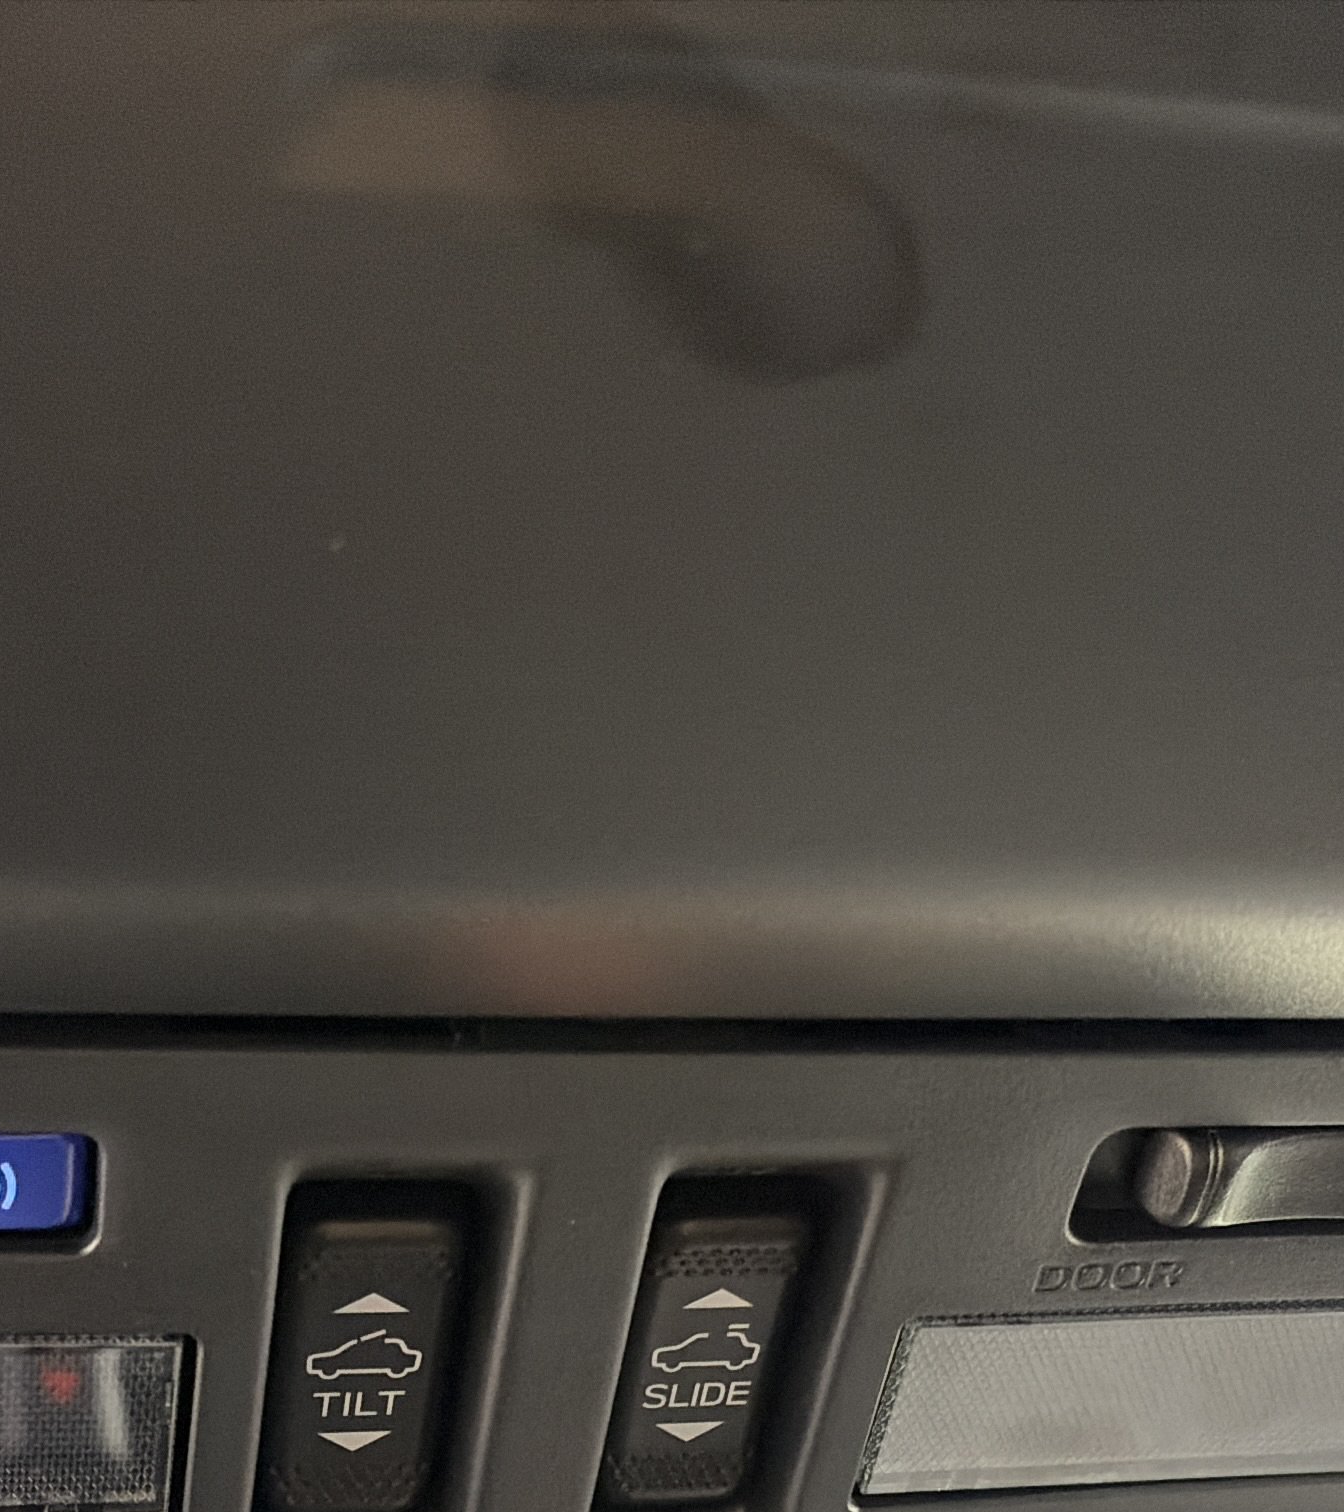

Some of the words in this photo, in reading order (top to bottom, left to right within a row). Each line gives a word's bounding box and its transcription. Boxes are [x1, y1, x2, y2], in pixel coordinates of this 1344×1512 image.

[1031, 1260, 1184, 1294] DOOR
[312, 1389, 407, 1418] TILT
[641, 1381, 752, 1410] SLIDE
